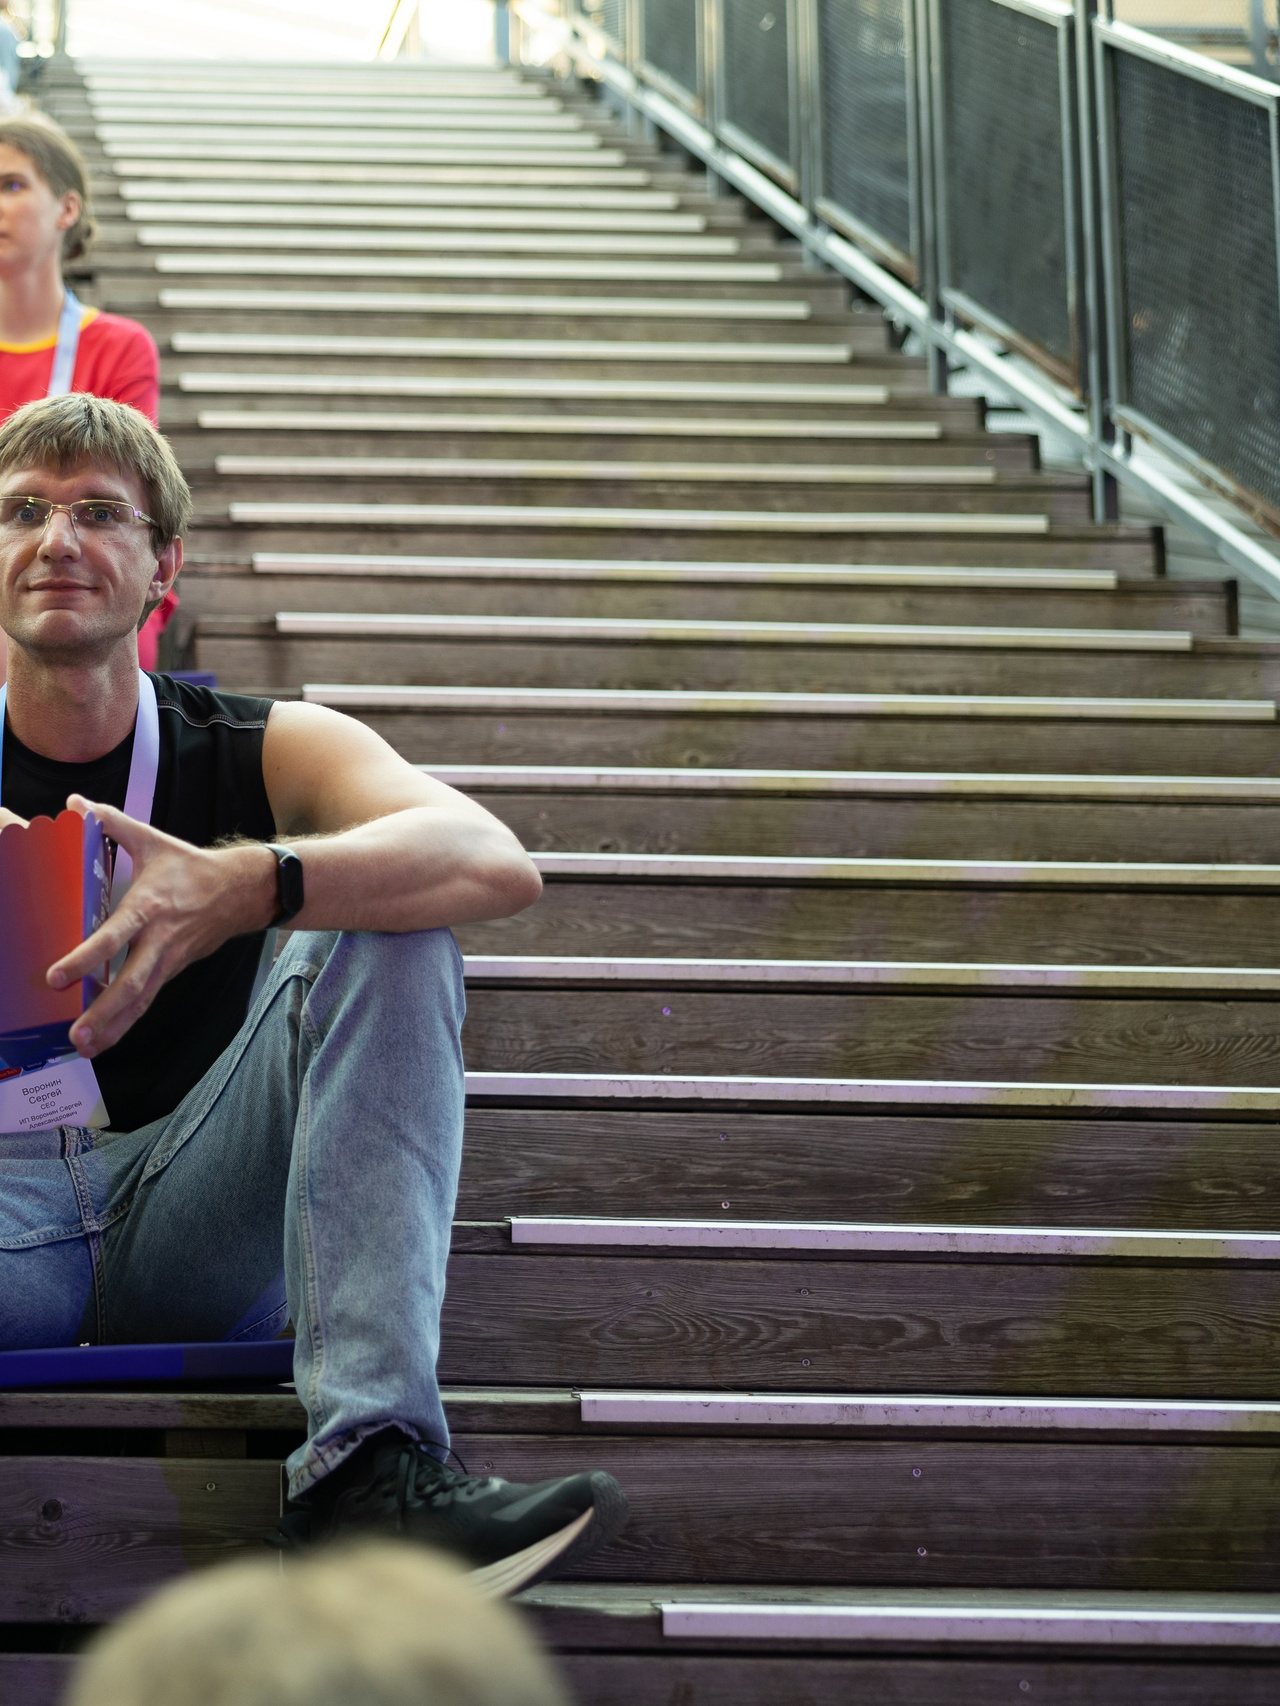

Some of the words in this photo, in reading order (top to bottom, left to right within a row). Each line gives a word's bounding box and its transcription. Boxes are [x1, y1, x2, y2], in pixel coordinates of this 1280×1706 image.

[21, 1079, 62, 1096] Воронин
[28, 1088, 62, 1104] Сергей
[19, 1117, 30, 1125] ИП
[31, 1109, 59, 1121] Воронин
[59, 1100, 83, 1112] Сергей
[40, 1101, 56, 1110] CEO
[29, 1111, 78, 1129] Александрович
